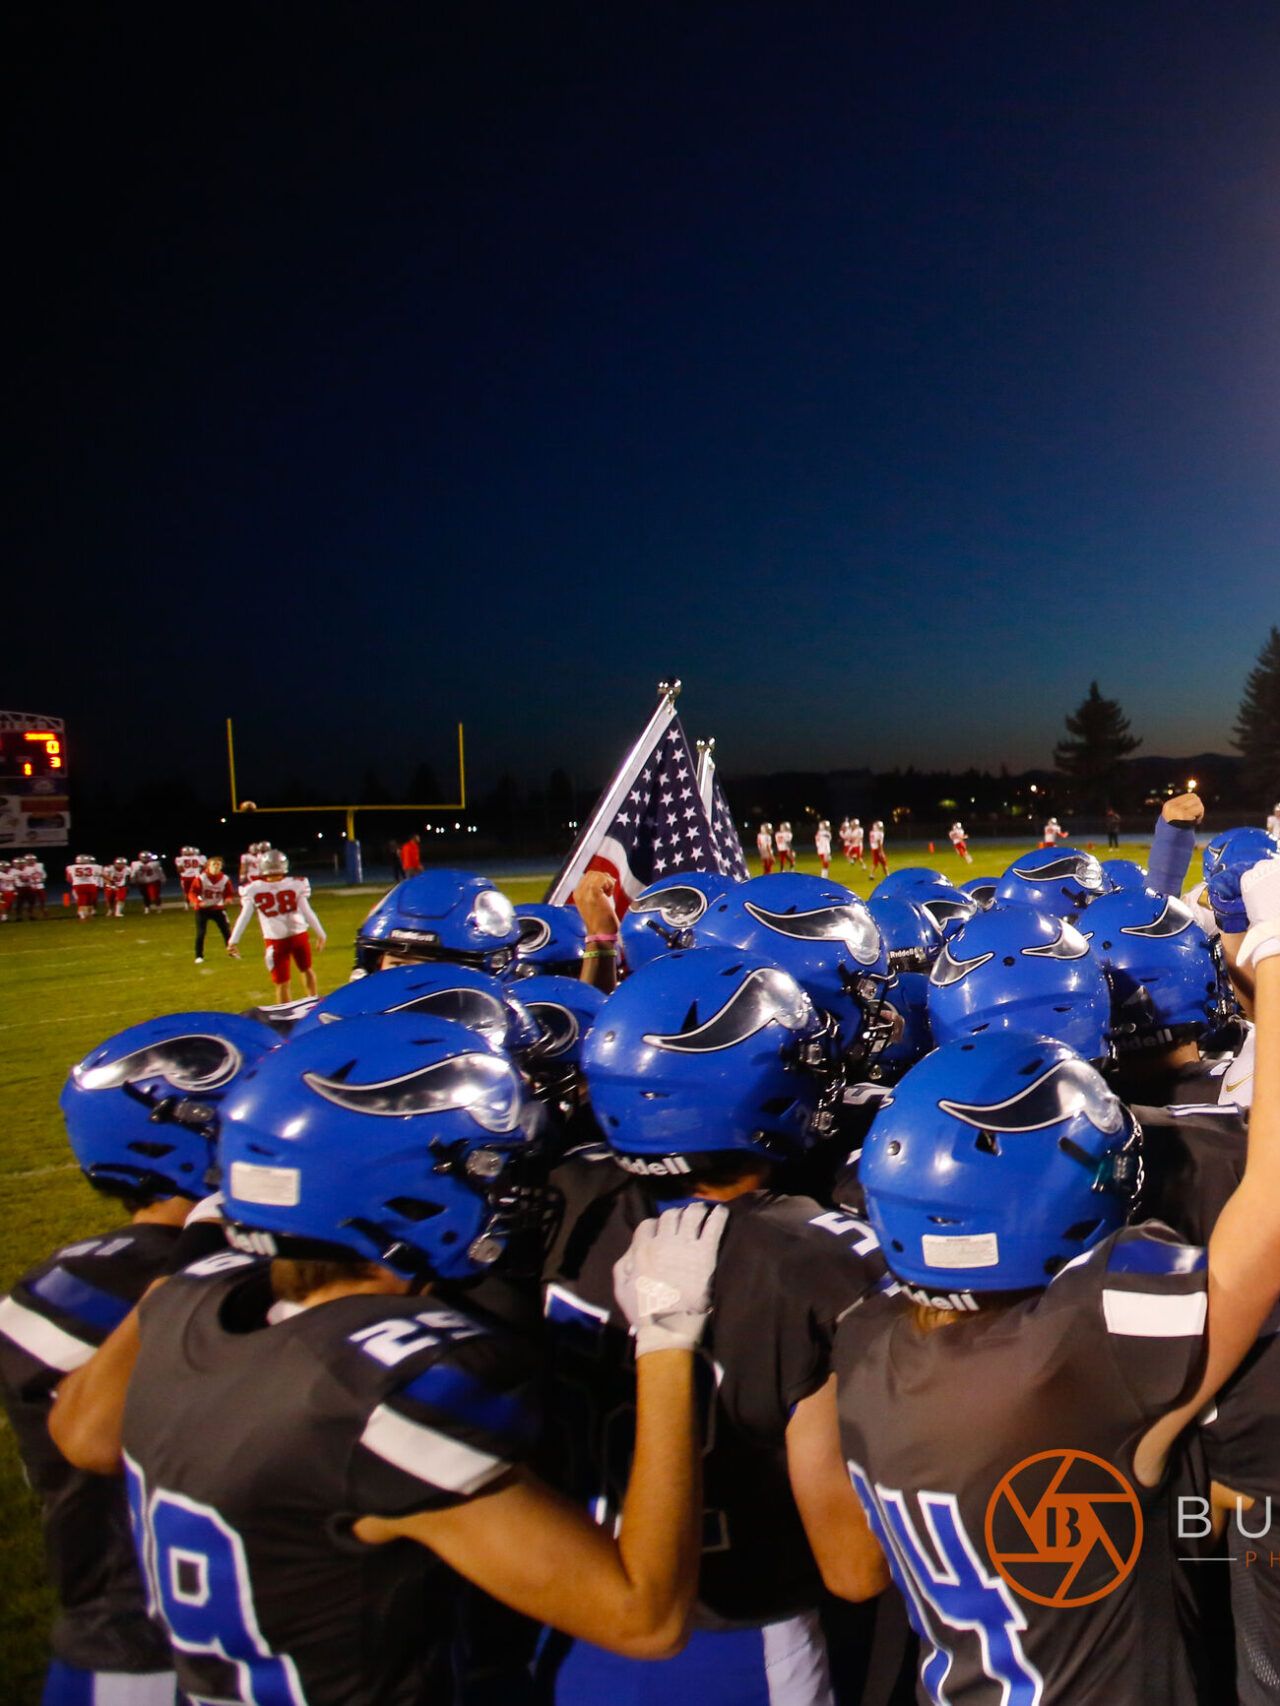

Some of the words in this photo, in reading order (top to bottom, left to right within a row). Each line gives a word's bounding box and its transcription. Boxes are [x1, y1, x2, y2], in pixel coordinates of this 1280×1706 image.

[74, 867, 94, 878] 53
[254, 889, 298, 918] 28
[615, 1156, 692, 1176] ddell
